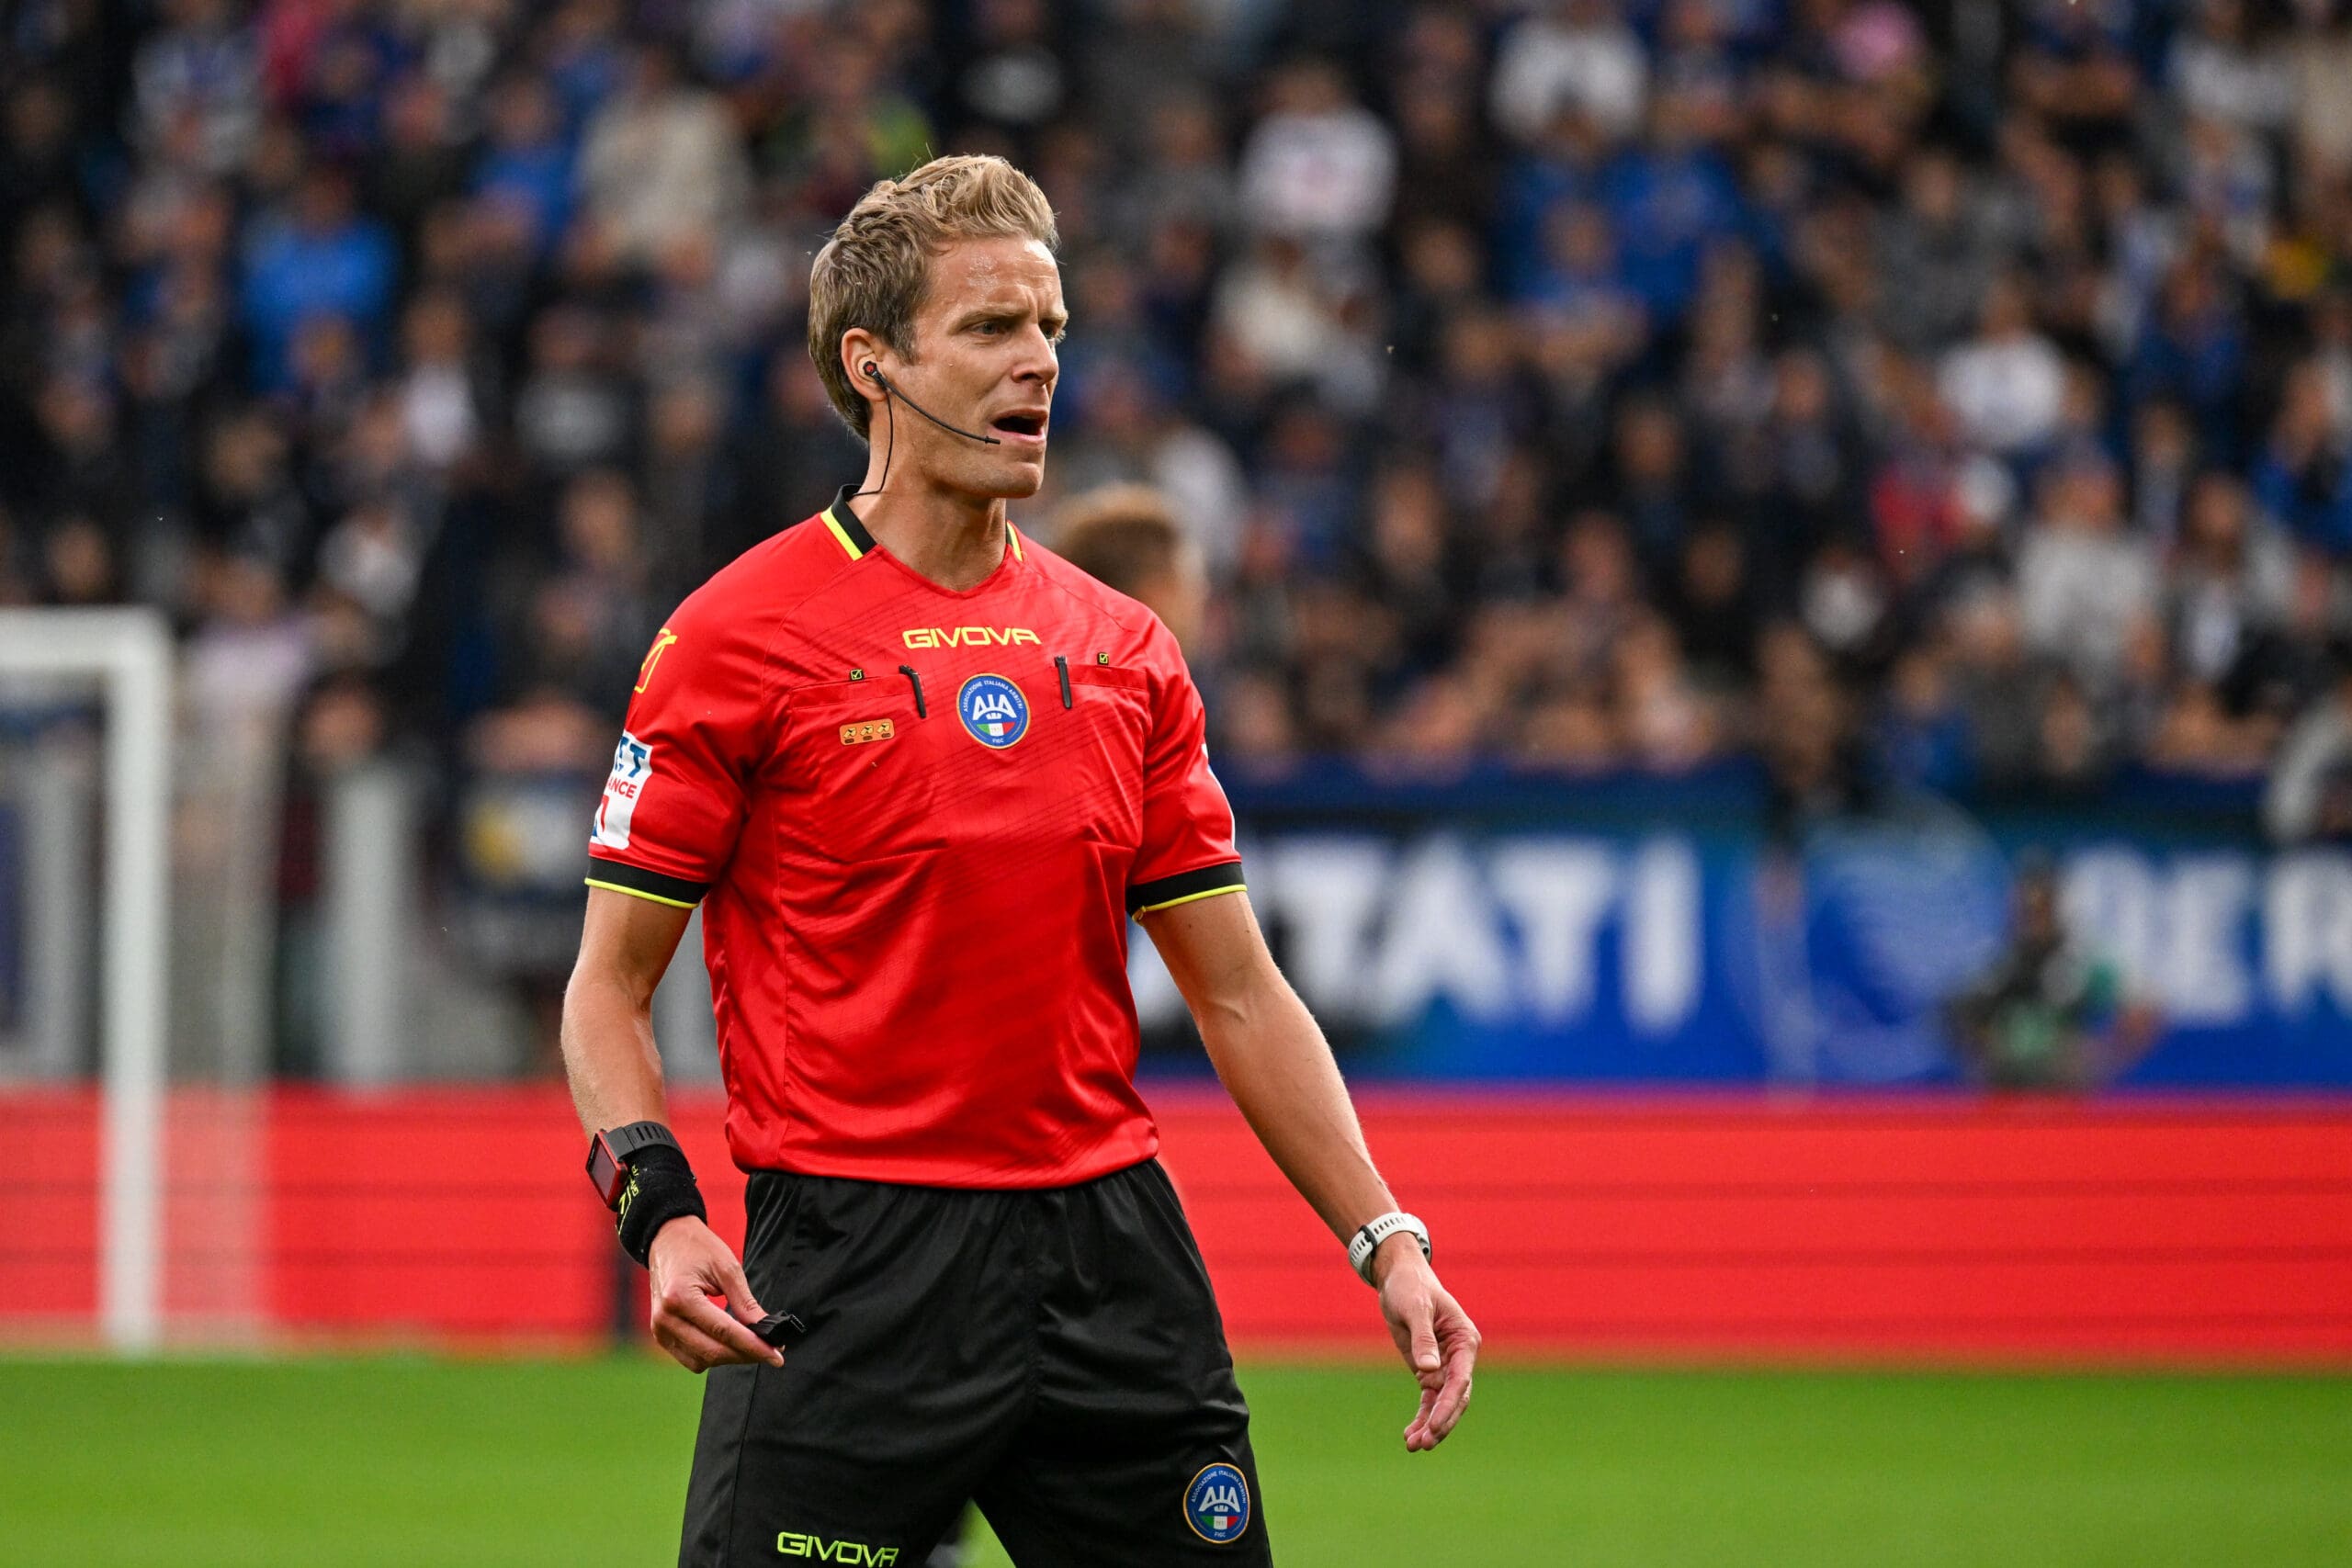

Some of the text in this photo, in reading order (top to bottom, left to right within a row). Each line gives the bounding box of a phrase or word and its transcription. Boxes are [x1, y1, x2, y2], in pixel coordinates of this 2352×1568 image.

[902, 626, 1043, 649] GIVOVA
[972, 694, 1017, 721] AIA
[1128, 831, 1711, 1040] TATI
[1198, 1485, 1241, 1513] AIA
[777, 1531, 899, 1567] GIVOVA
